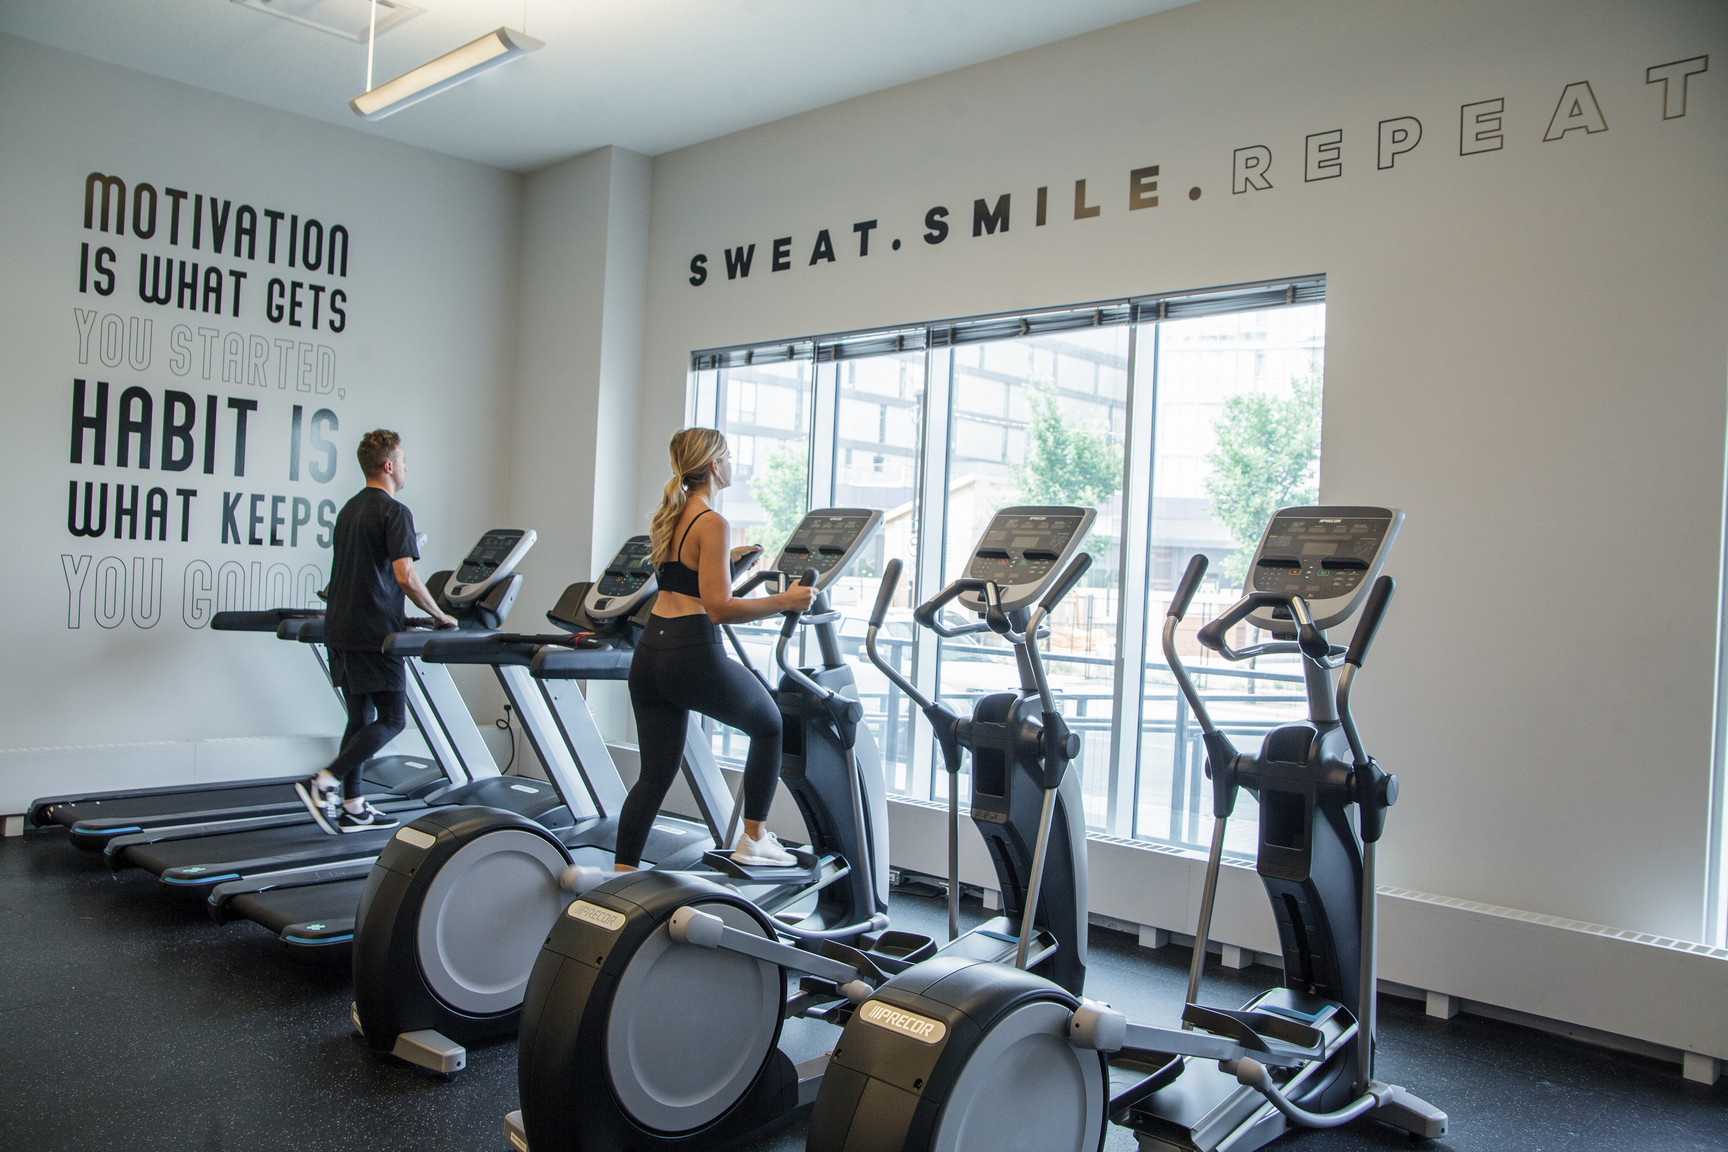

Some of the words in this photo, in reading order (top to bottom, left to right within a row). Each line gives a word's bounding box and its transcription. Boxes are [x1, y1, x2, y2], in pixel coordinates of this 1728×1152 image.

[1232, 55, 1708, 194] REPEAT
[84, 172, 348, 277] MOTIVATION
[79, 242, 117, 296] IS
[139, 253, 247, 317] WHAT
[266, 277, 347, 333] GETS
[73, 308, 153, 371] YOU
[169, 324, 346, 400] STARTED,
[70, 378, 258, 477] HABIT
[289, 405, 339, 483] IS
[67, 480, 197, 542] WHAT
[221, 491, 336, 549] KEEPS
[61, 554, 163, 629] YOU
[577, 905, 618, 926] PRECOR
[874, 1007, 935, 1037] PRECOR
